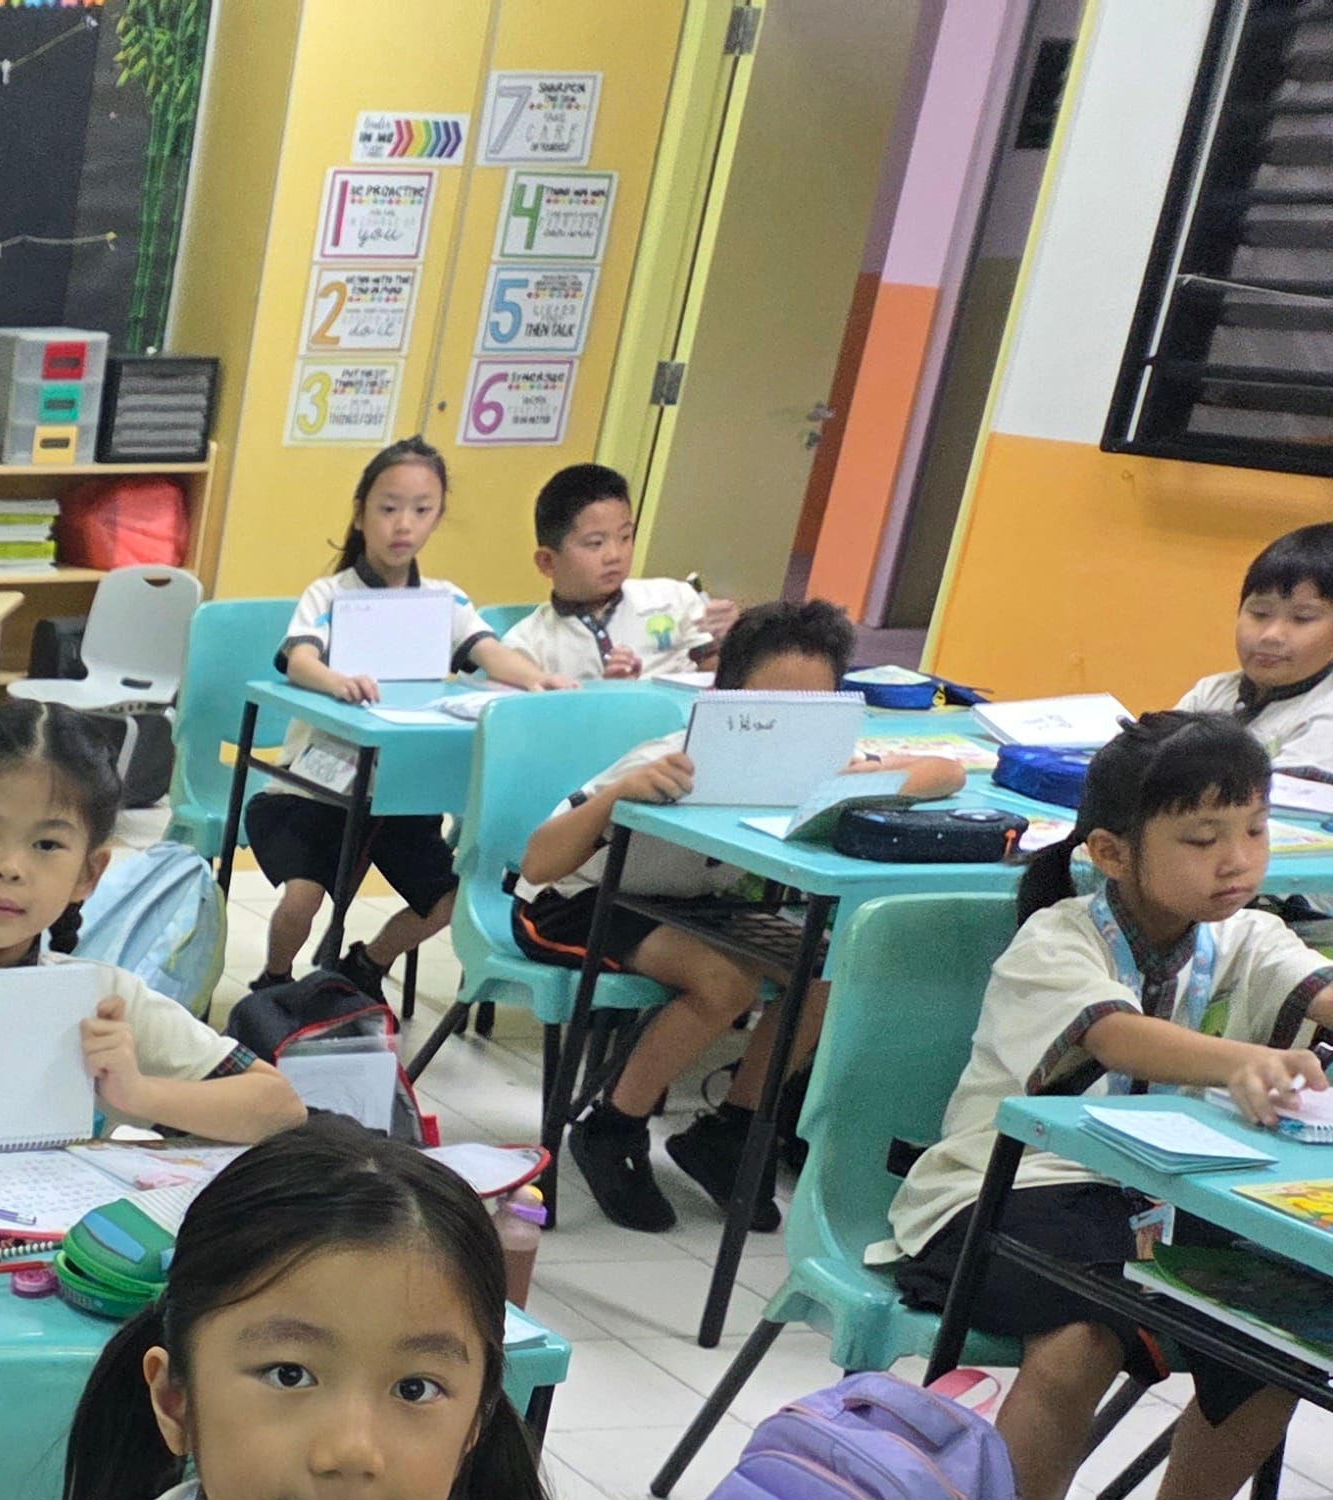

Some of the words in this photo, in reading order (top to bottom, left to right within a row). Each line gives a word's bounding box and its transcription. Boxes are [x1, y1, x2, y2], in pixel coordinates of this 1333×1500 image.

[490, 85, 531, 153] 7
[512, 183, 544, 250] 4
[310, 281, 347, 344] 2
[489, 278, 529, 344] 5
[297, 371, 331, 435] 3
[472, 371, 508, 435] 6
